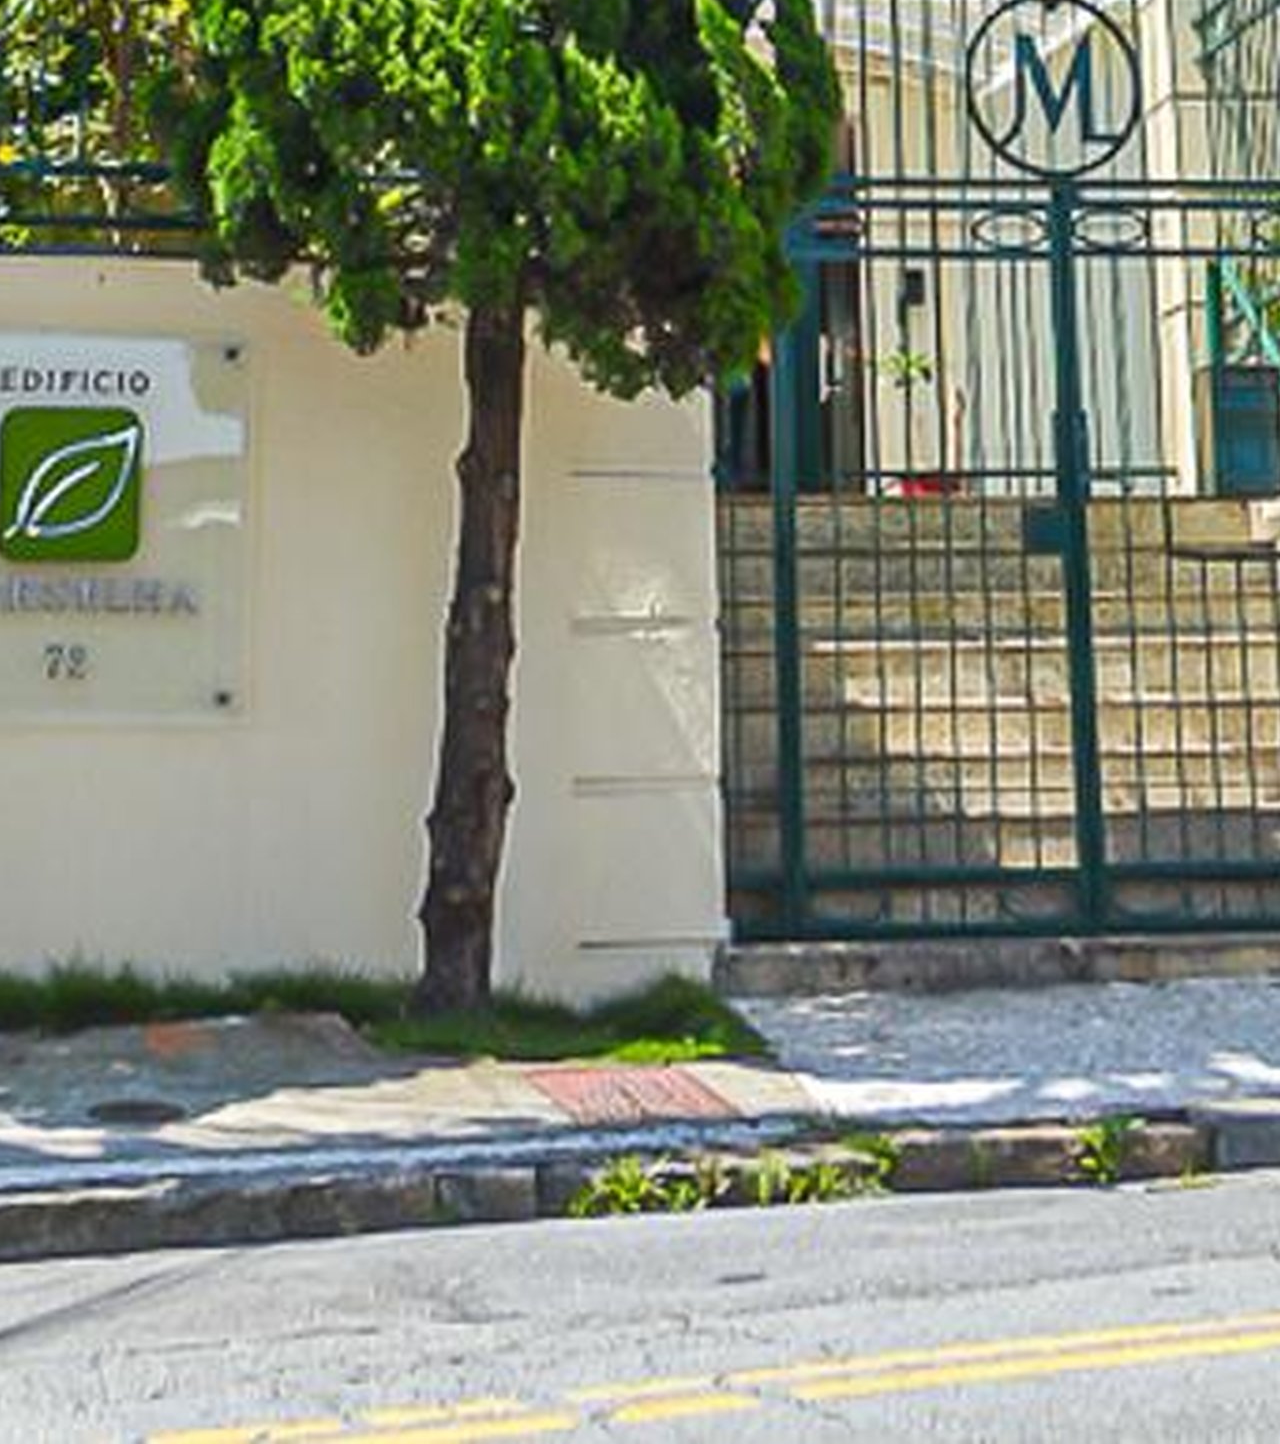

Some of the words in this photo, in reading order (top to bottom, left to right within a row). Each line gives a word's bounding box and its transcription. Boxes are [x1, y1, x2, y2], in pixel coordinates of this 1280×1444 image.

[1002, 30, 1121, 147] M
[0, 367, 151, 396] EDIFICIO
[44, 643, 88, 681] 72
